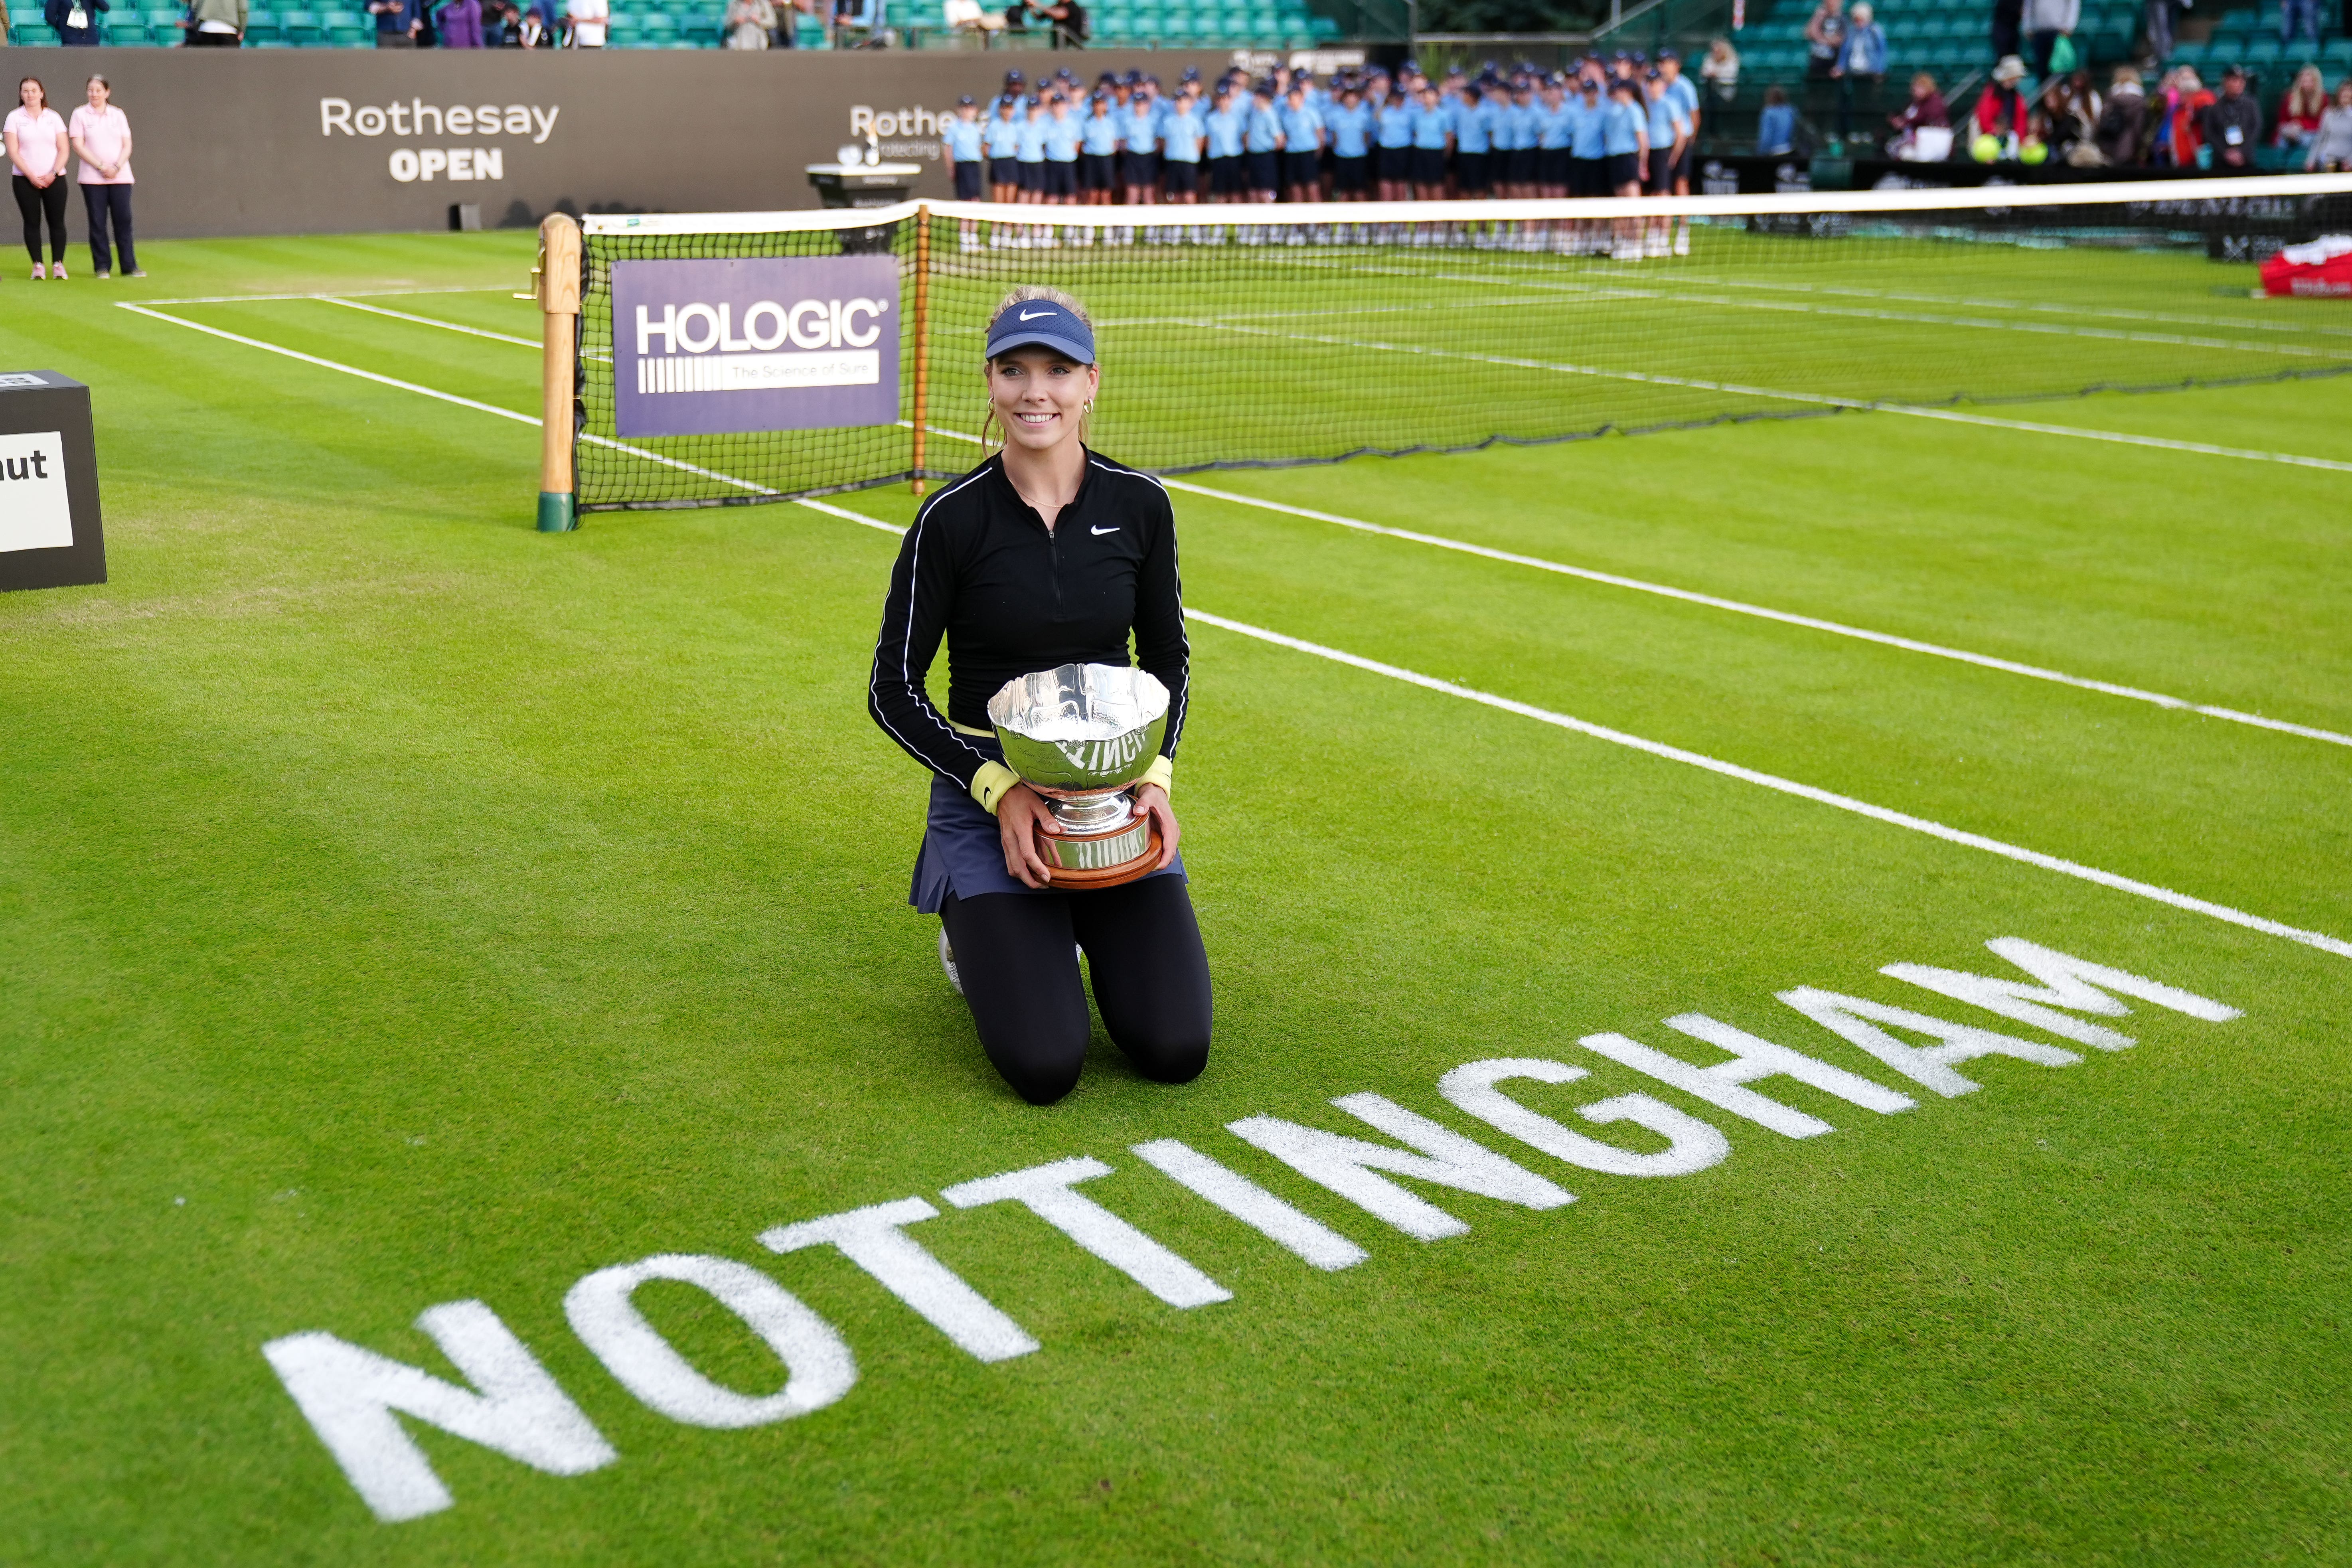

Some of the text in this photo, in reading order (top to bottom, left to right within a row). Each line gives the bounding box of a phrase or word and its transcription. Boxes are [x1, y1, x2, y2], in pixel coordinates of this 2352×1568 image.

[320, 97, 560, 144] Rothesay
[388, 147, 504, 182] OPEN
[732, 362, 869, 379] The Science of Sure
[261, 936, 2244, 1521] NOTTINGHAM
